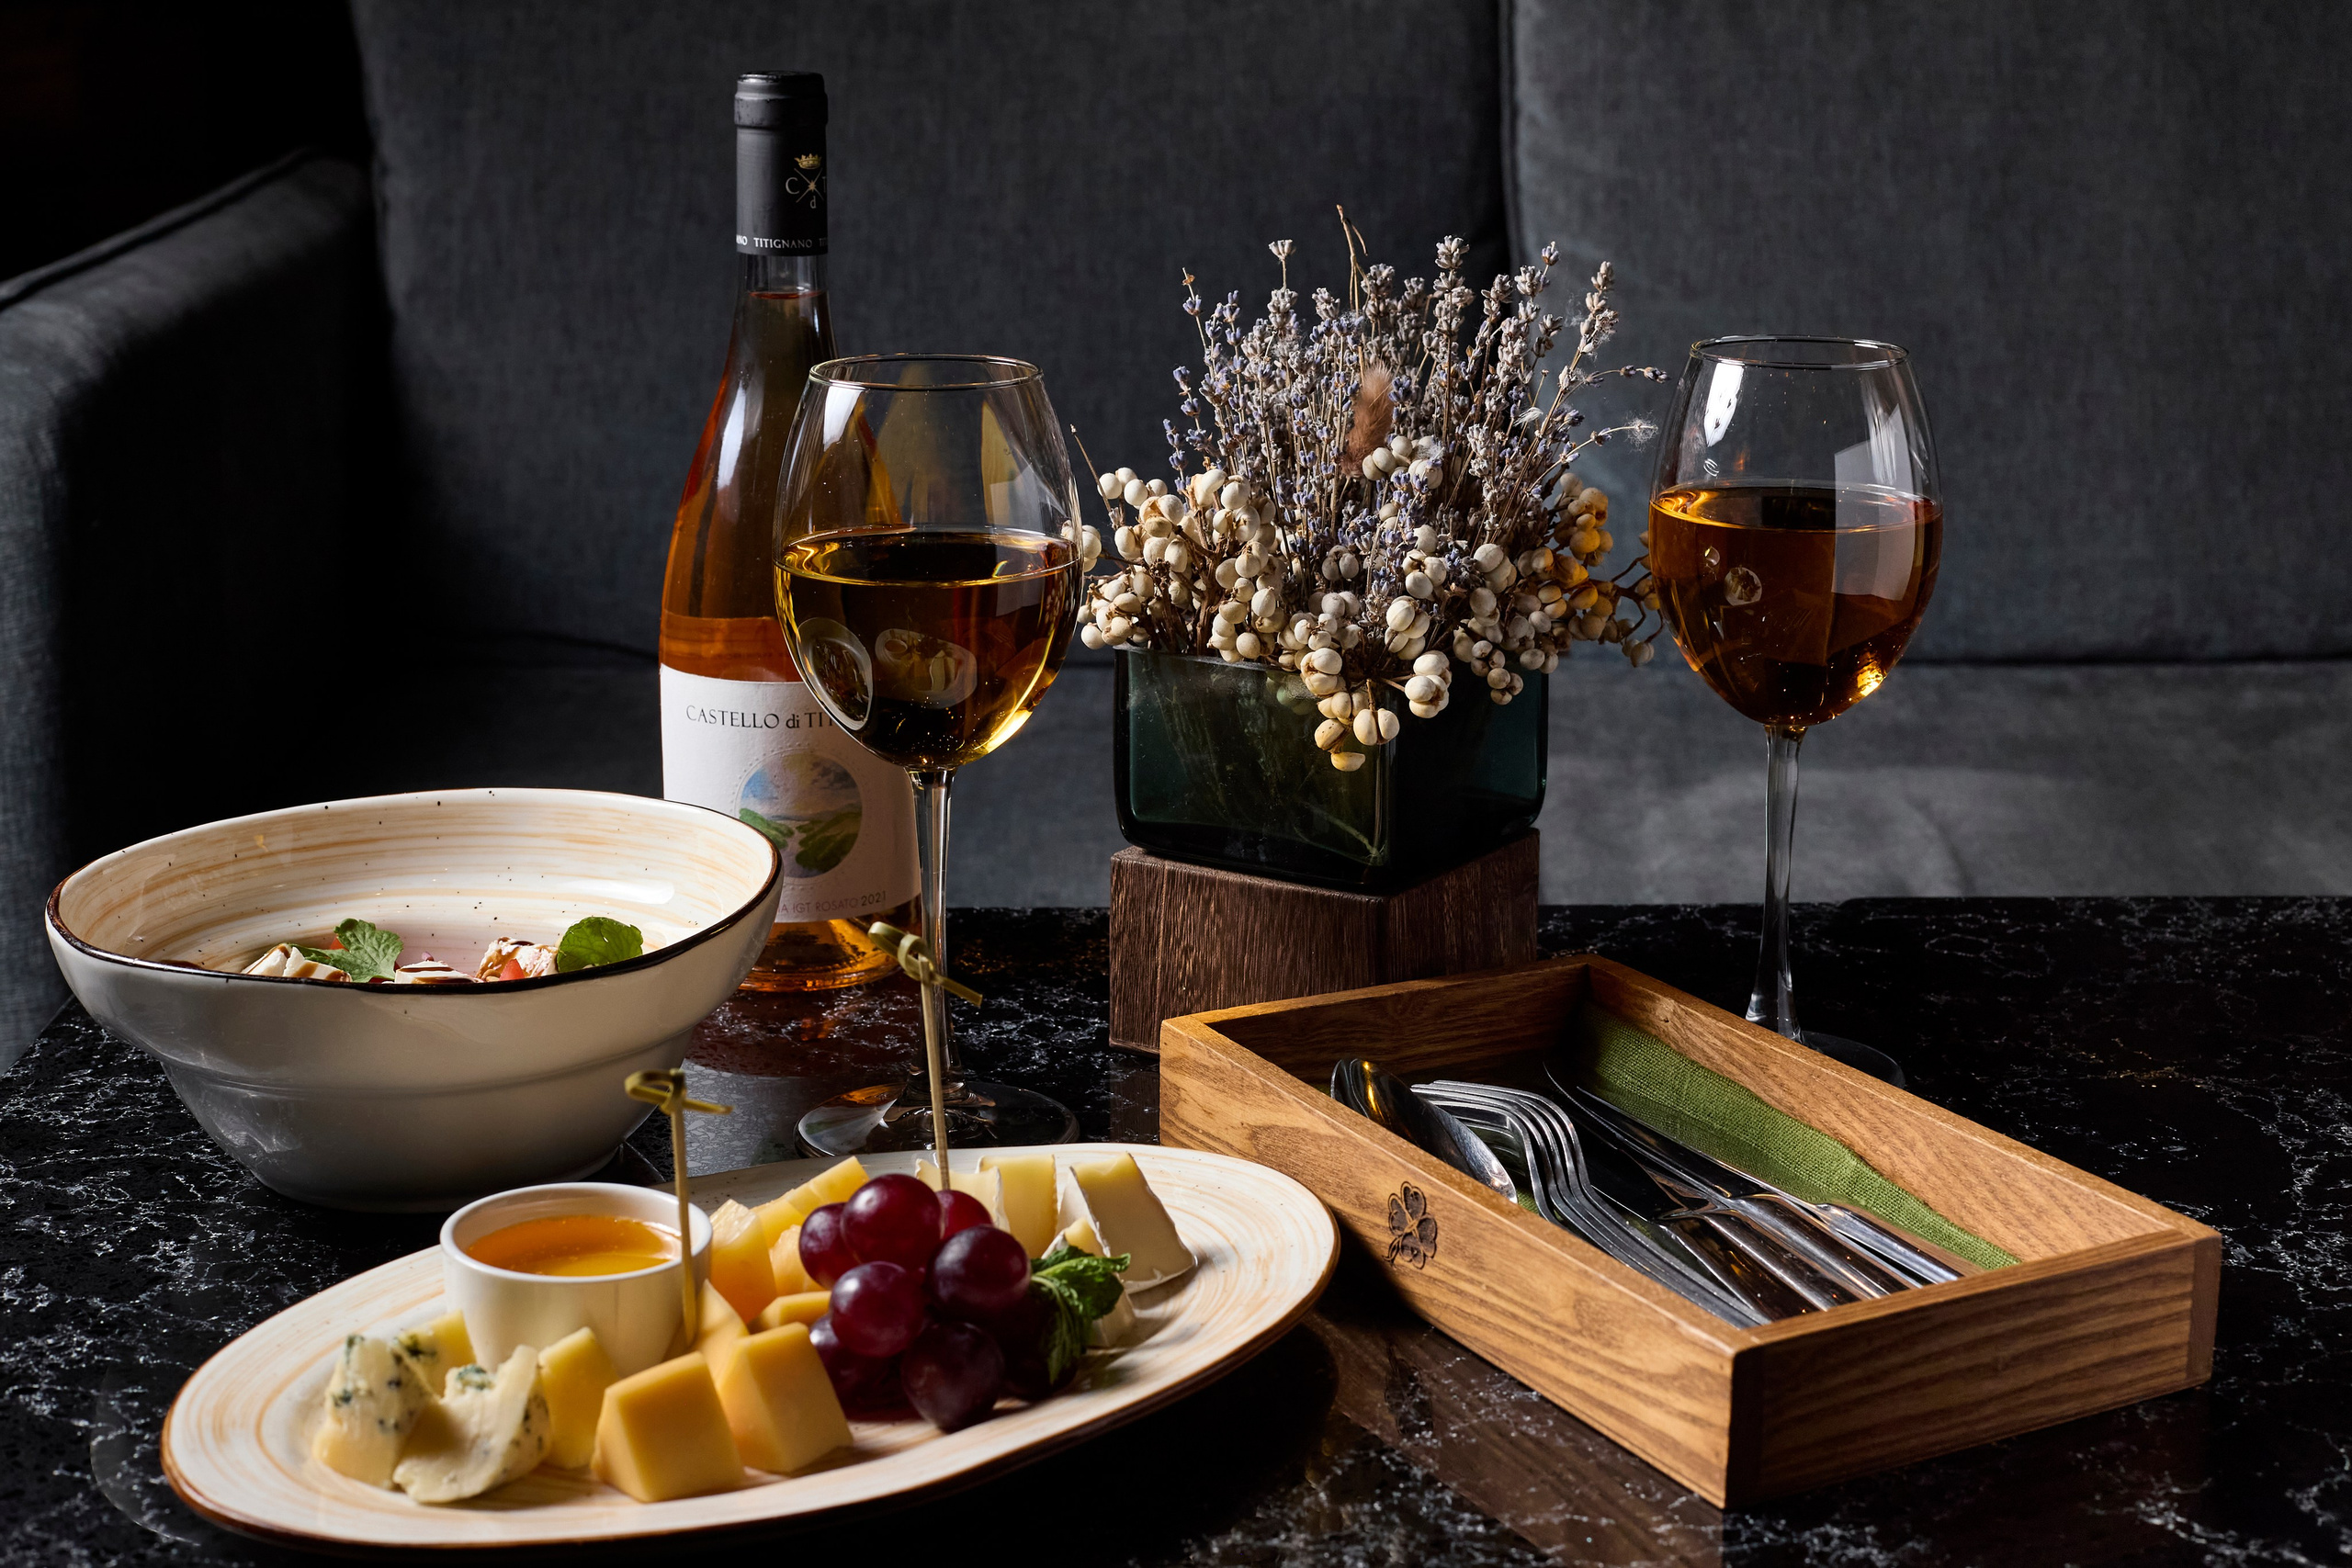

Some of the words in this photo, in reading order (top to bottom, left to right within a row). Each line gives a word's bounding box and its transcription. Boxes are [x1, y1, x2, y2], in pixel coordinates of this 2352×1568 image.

[785, 176, 799, 195] C
[809, 196, 817, 209] d
[753, 237, 812, 249] TITIGNANO
[686, 705, 780, 728] CASTELLO
[786, 714, 800, 728] di
[792, 901, 810, 914] IGT
[815, 897, 858, 913] ROSATO
[861, 890, 886, 907] 2021
